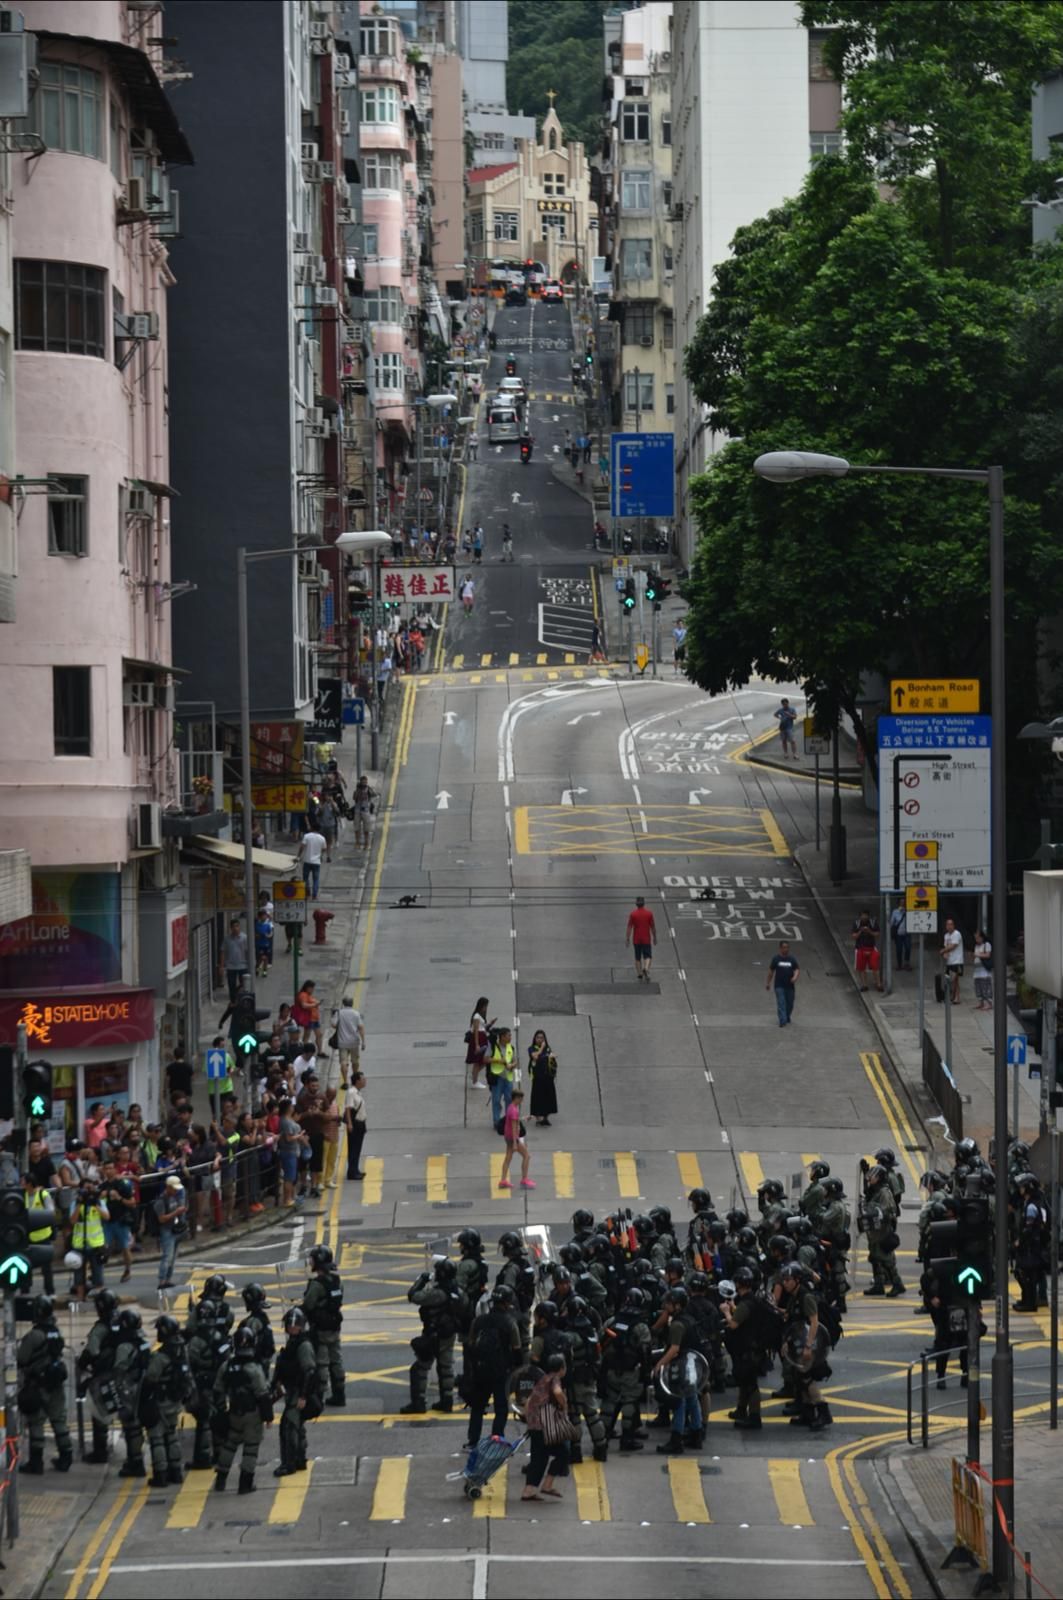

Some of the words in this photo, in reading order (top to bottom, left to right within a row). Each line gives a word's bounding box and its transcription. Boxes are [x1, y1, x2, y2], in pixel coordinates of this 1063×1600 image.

[908, 683, 945, 692] Bonham
[949, 683, 974, 692] Road
[896, 718, 929, 726] Diversion
[931, 718, 944, 726] For
[946, 718, 975, 726] Vehicles
[932, 762, 949, 770] High
[912, 831, 929, 839] First
[932, 831, 955, 839] Street
[663, 875, 806, 888] QUEENS
[747, 889, 775, 900] W
[0, 920, 70, 940] ArtLane
[703, 920, 803, 941] 道西
